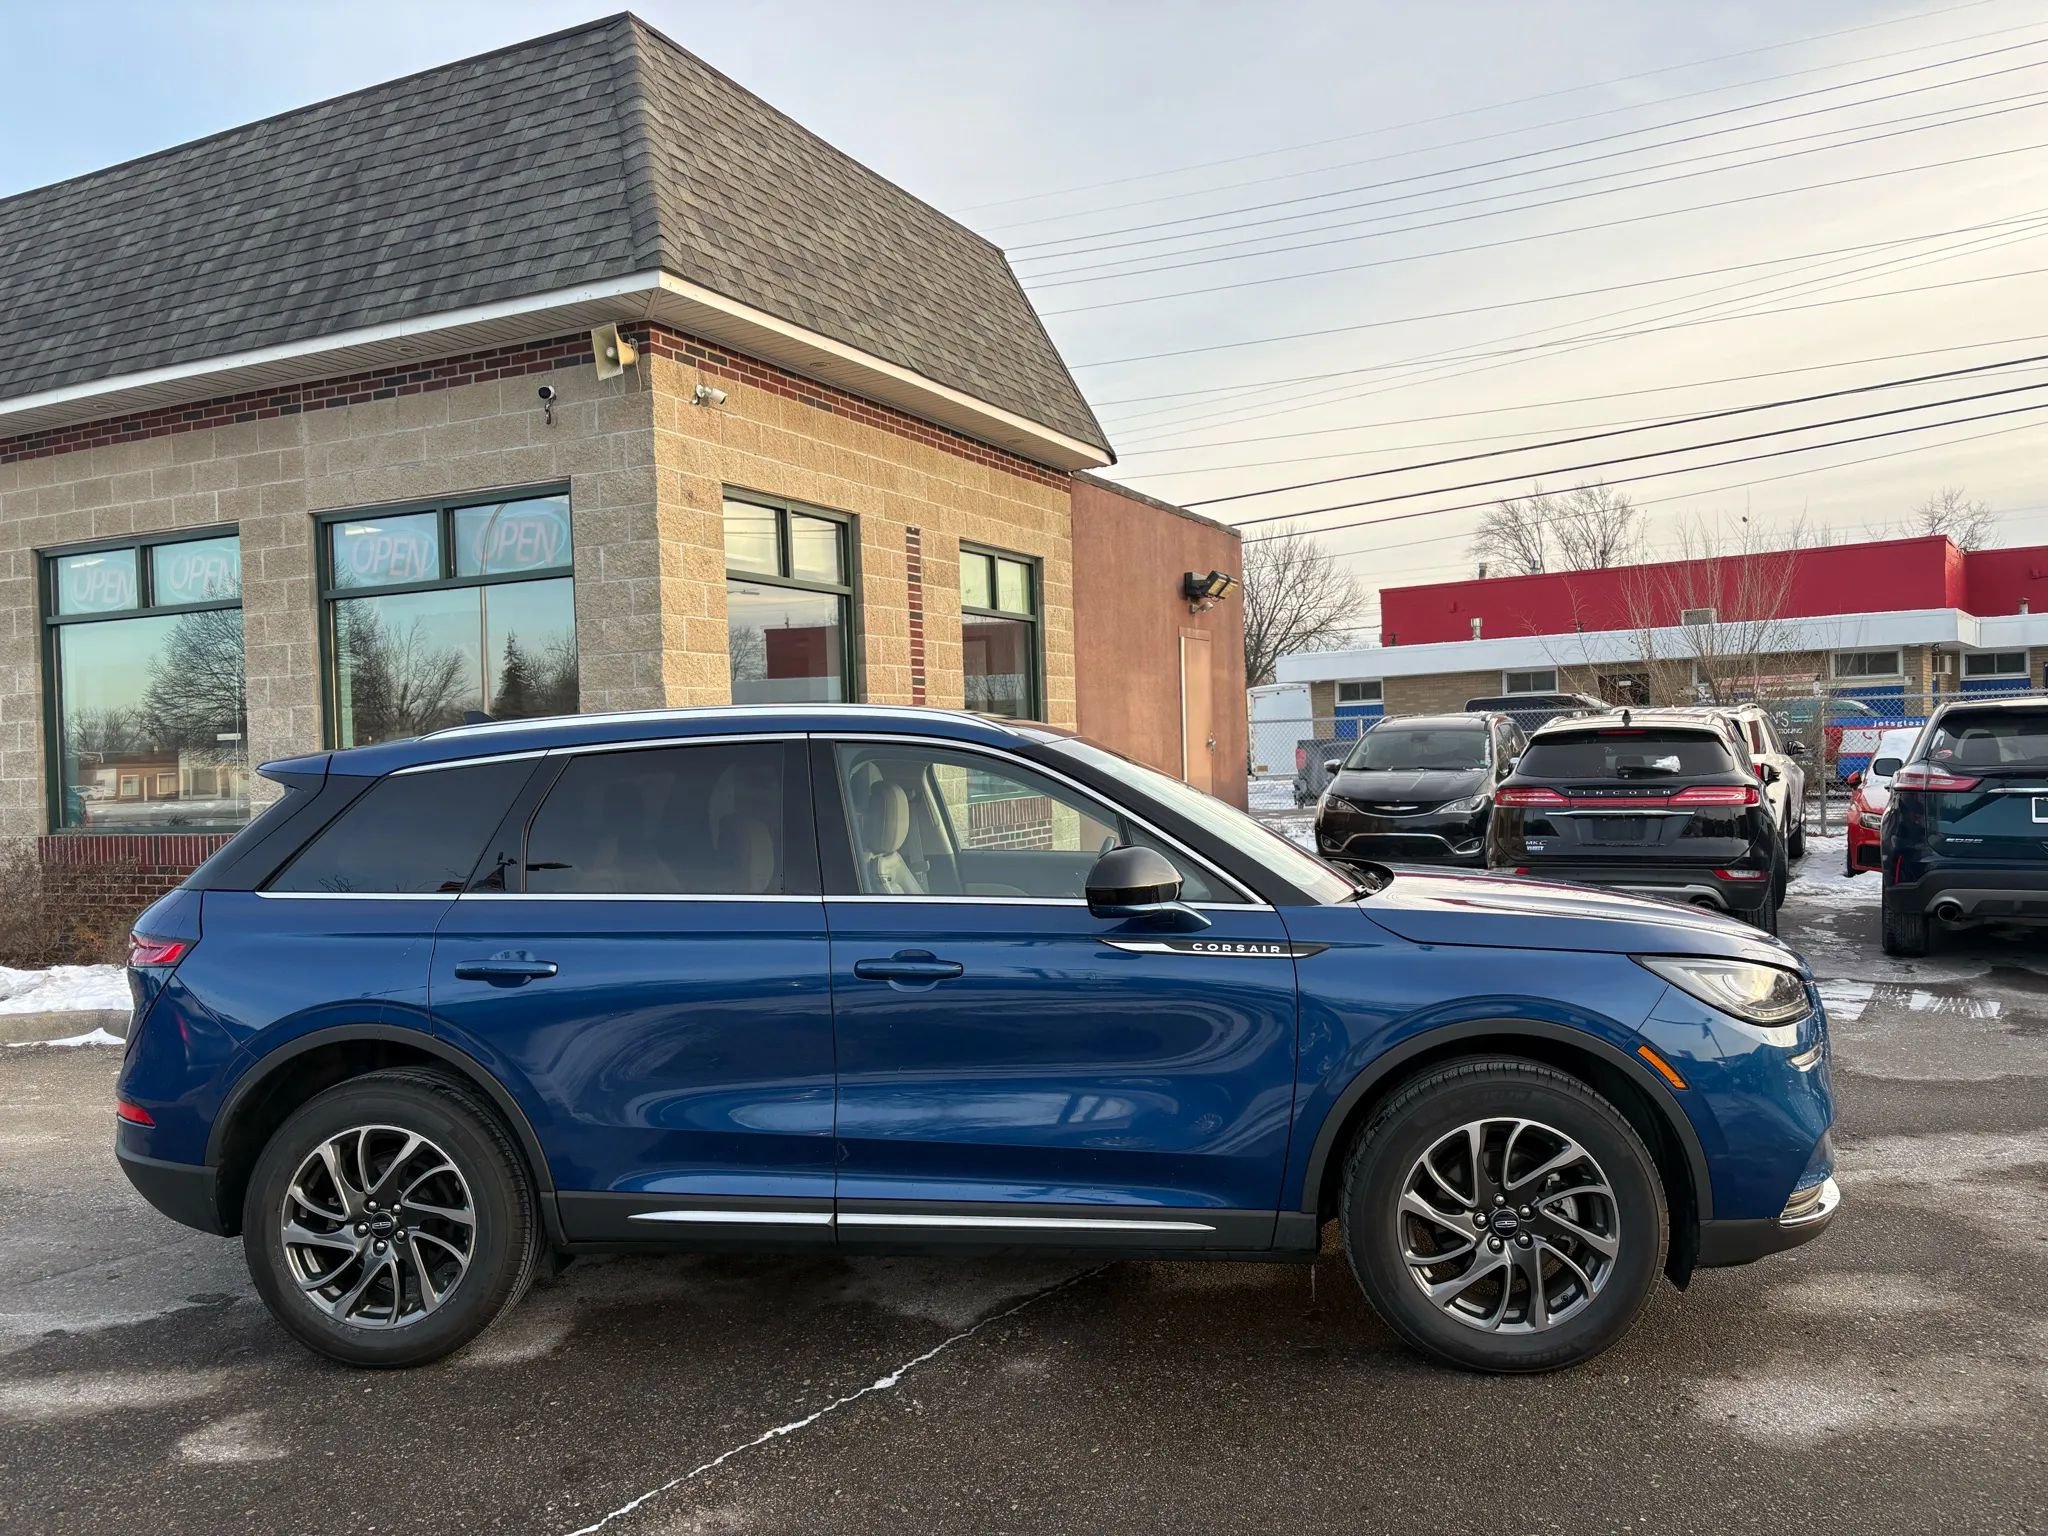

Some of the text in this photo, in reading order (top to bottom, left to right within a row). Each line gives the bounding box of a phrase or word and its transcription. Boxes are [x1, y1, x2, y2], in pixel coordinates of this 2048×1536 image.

[351, 534, 430, 578] OPEN
[472, 519, 559, 563] OPEN
[72, 567, 136, 604] OPEN
[1873, 719, 1926, 728] jetsglazi
[1192, 943, 1281, 954] CORSAIR
